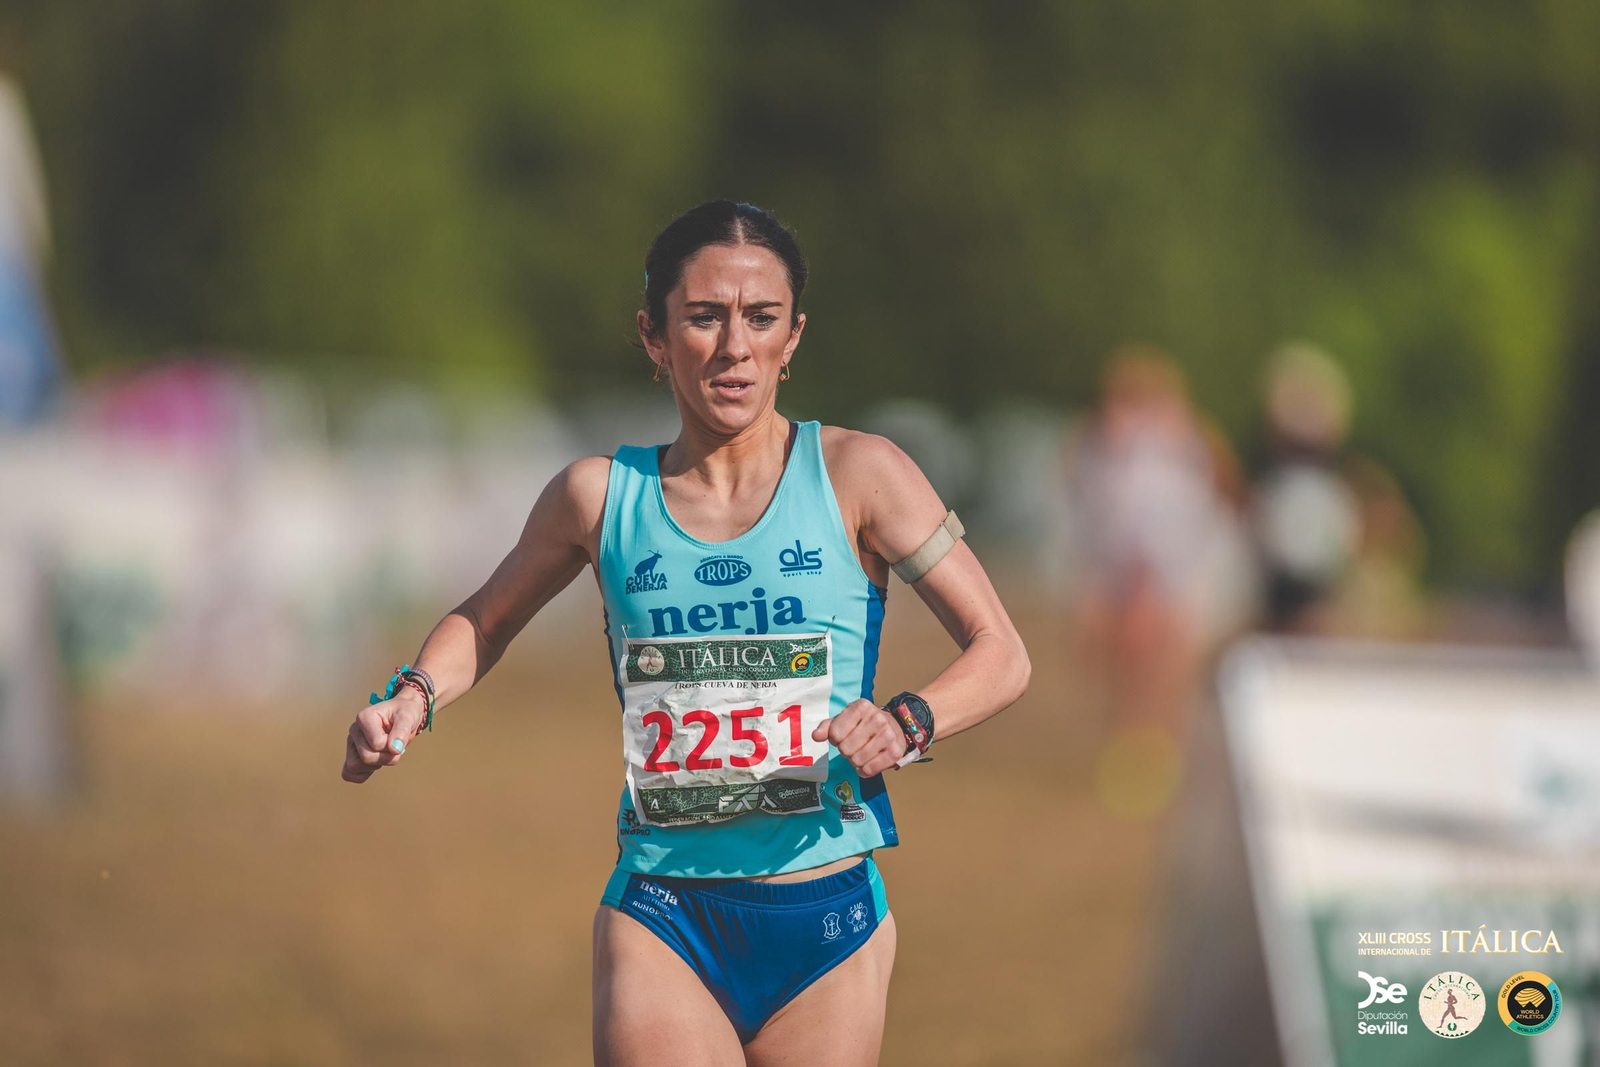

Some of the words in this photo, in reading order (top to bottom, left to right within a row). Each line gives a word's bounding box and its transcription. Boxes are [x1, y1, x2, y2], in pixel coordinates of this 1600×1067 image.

[626, 573, 668, 587] CUEVA
[697, 561, 749, 581] TROPS
[648, 587, 807, 637] nerja
[677, 642, 777, 668] ITÁLICA
[736, 681, 749, 689] DE
[750, 681, 778, 689] NERJA
[642, 704, 815, 773] 2251
[640, 880, 678, 906] nerja
